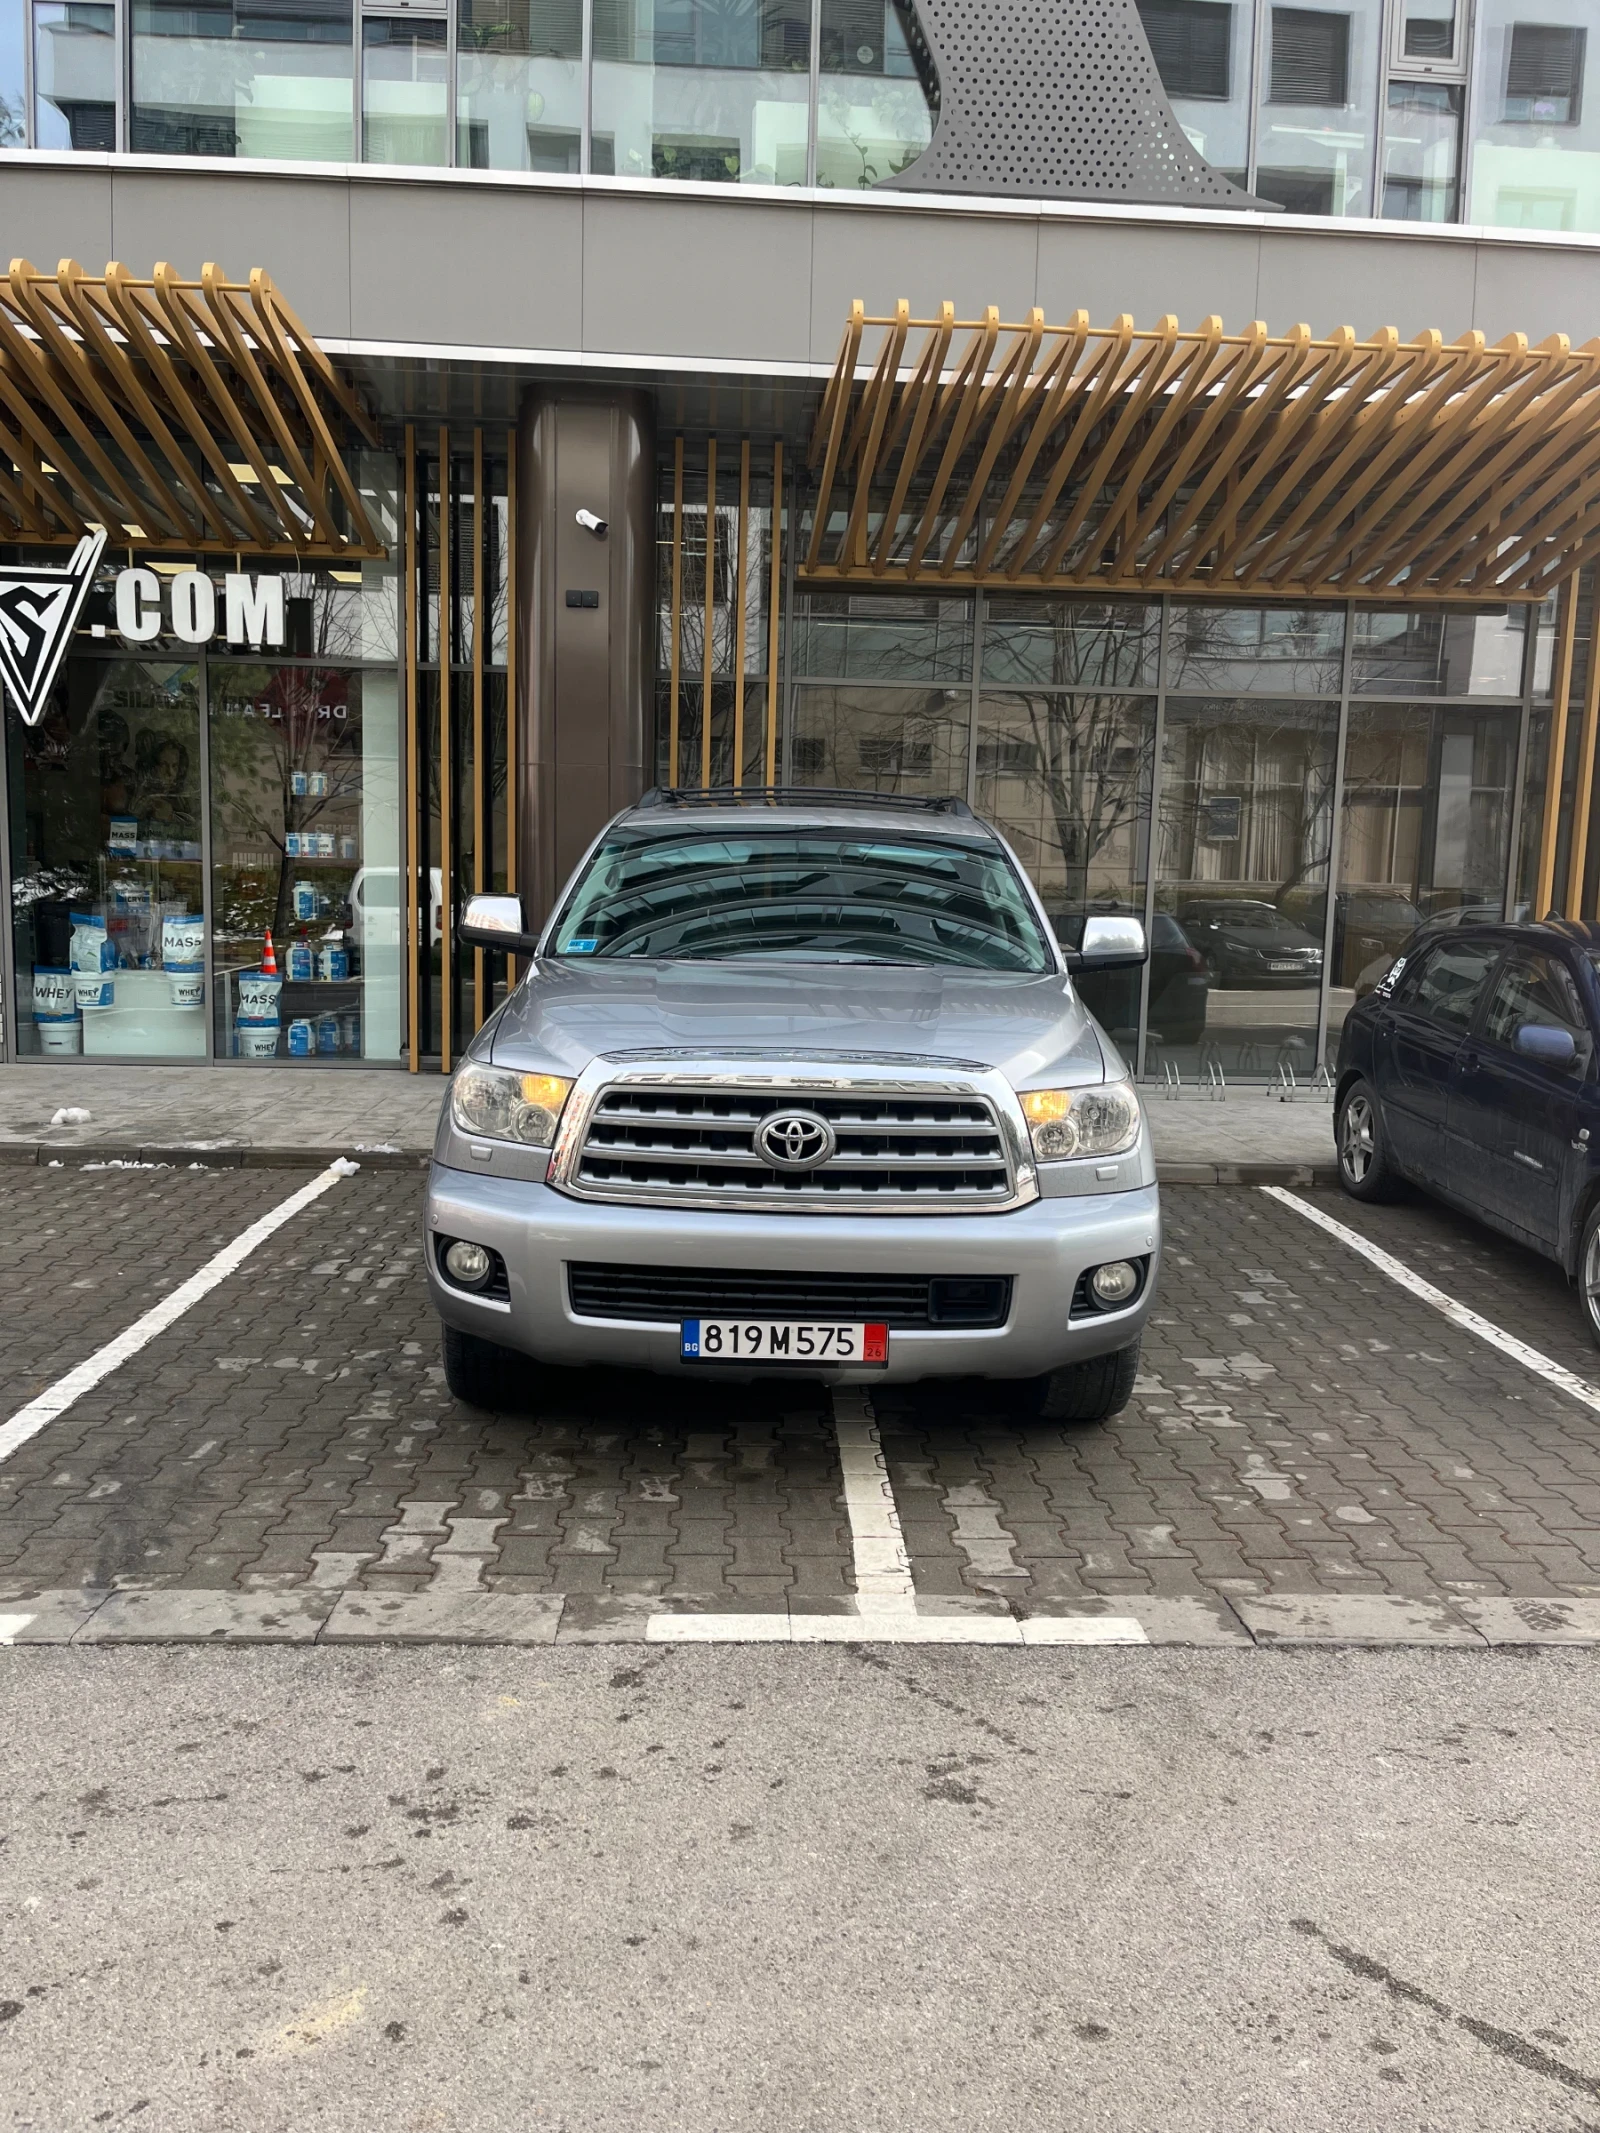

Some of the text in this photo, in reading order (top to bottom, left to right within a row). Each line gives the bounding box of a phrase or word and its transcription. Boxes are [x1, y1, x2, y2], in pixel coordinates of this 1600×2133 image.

[111, 831, 136, 839] MASS
[164, 936, 202, 948] MASS
[35, 987, 73, 999] WHEY
[78, 988, 98, 997] WHEY
[178, 988, 200, 997] WHEY
[241, 994, 277, 1005] MASS
[254, 1043, 275, 1051] WHEY
[704, 1324, 855, 1356] 819M575
[684, 1342, 698, 1352] BG
[867, 1347, 882, 1357] 26
